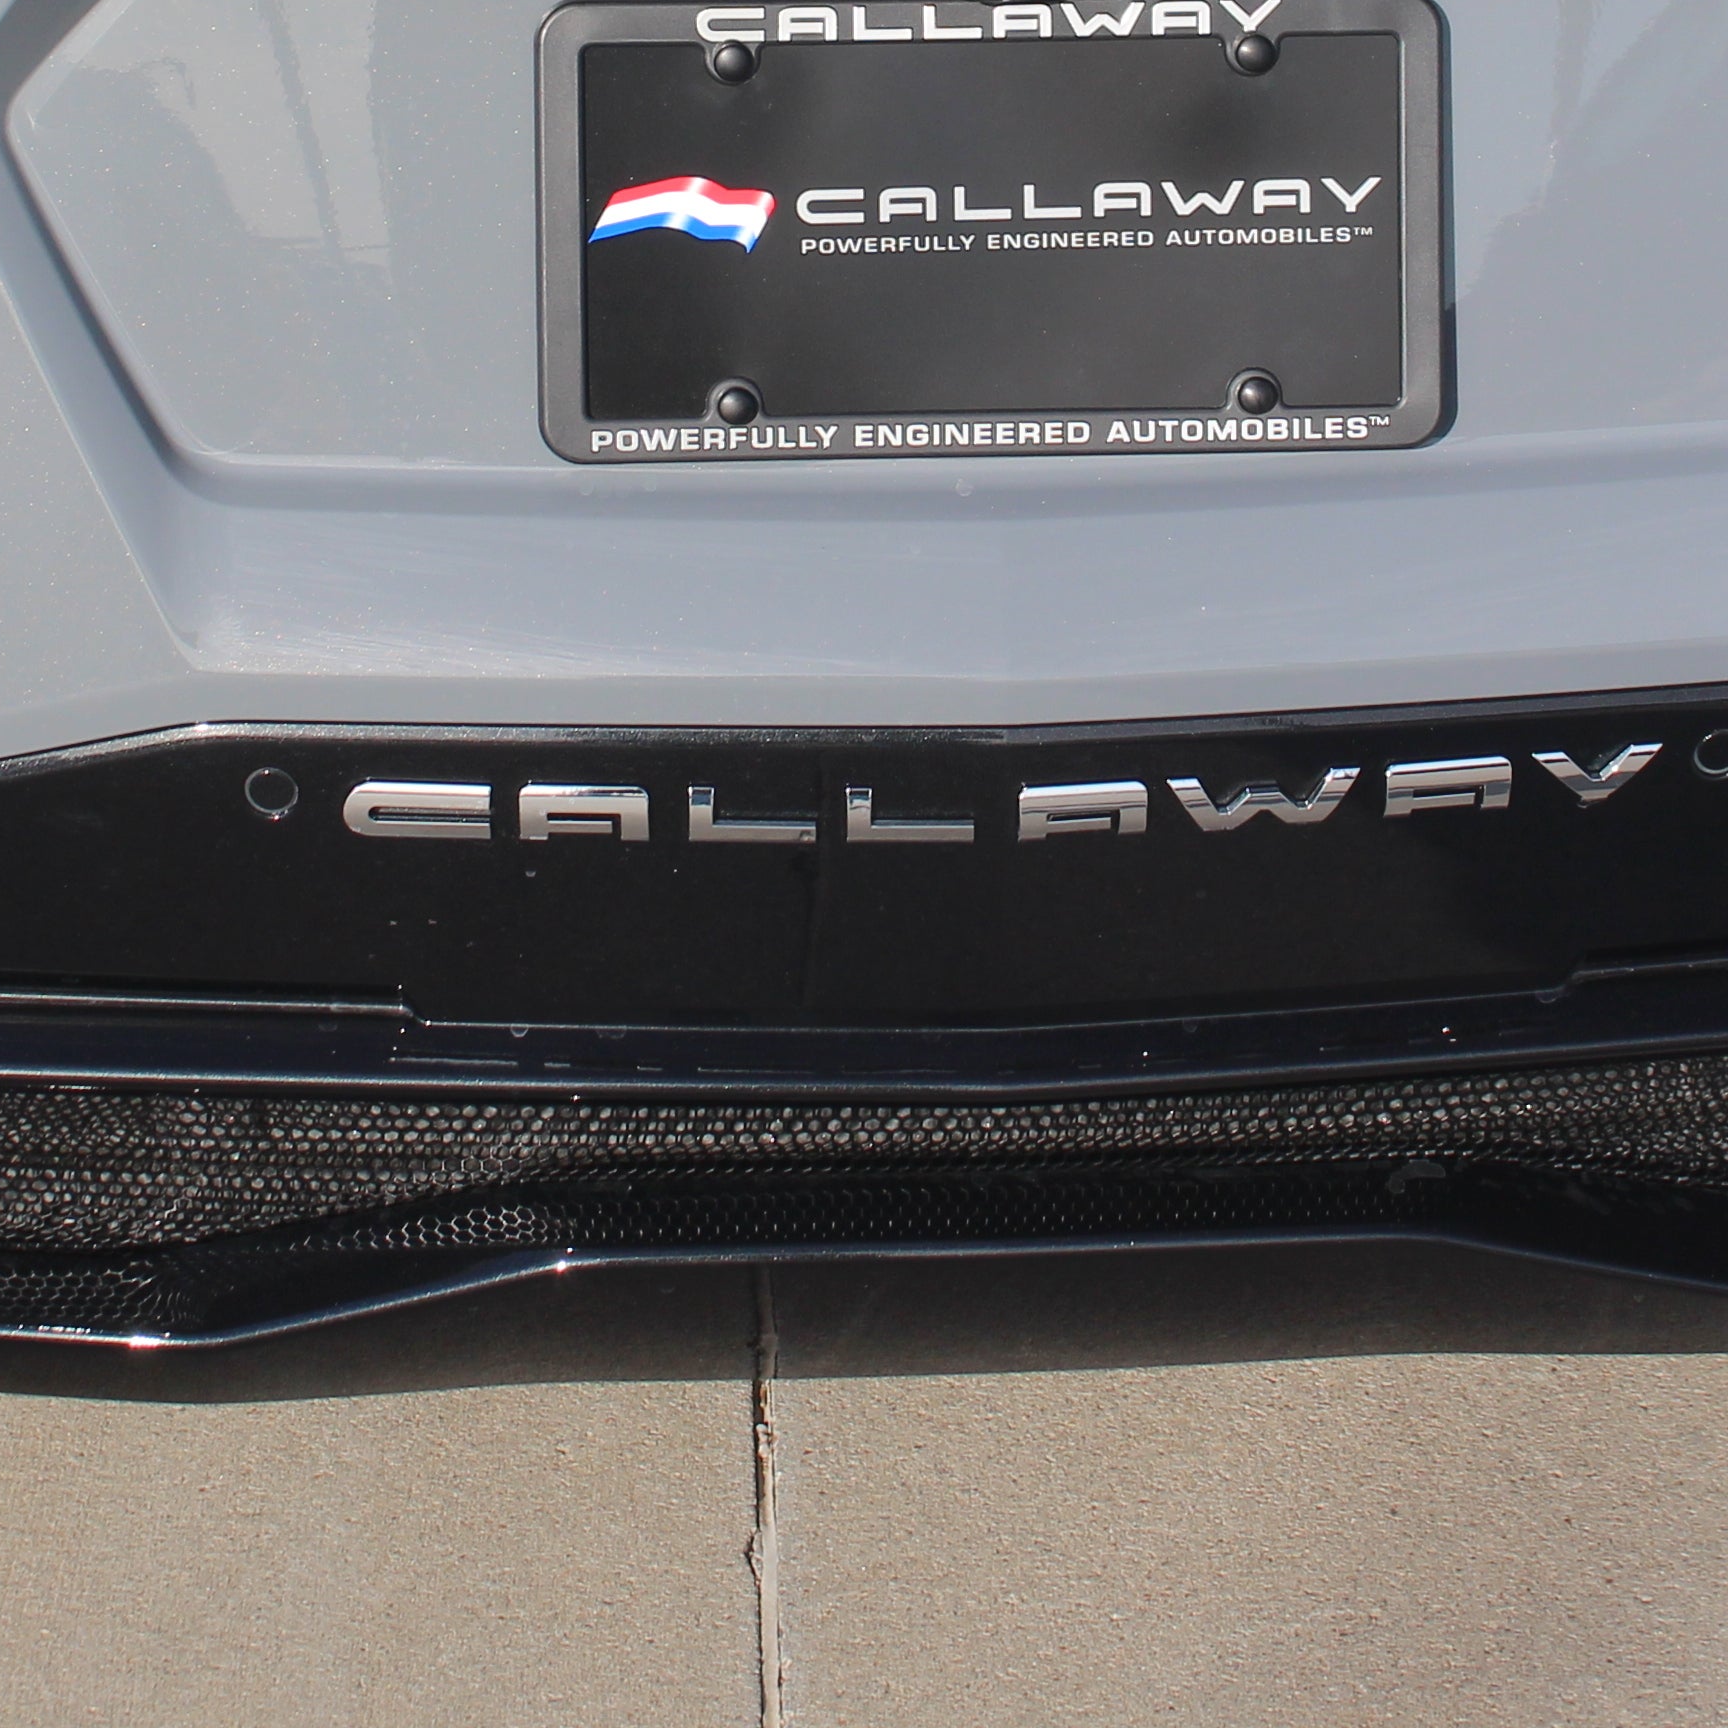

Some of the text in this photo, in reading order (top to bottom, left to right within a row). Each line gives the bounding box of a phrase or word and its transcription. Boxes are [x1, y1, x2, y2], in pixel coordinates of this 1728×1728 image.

[795, 176, 1383, 225] CALLAWAY
[800, 233, 977, 255] POWERFULLY
[986, 230, 1155, 251] ENGINEERED
[589, 423, 840, 454] POWERFULLY
[853, 419, 1092, 450] ENGINEERED
[341, 741, 1664, 843] CALLAWAY
